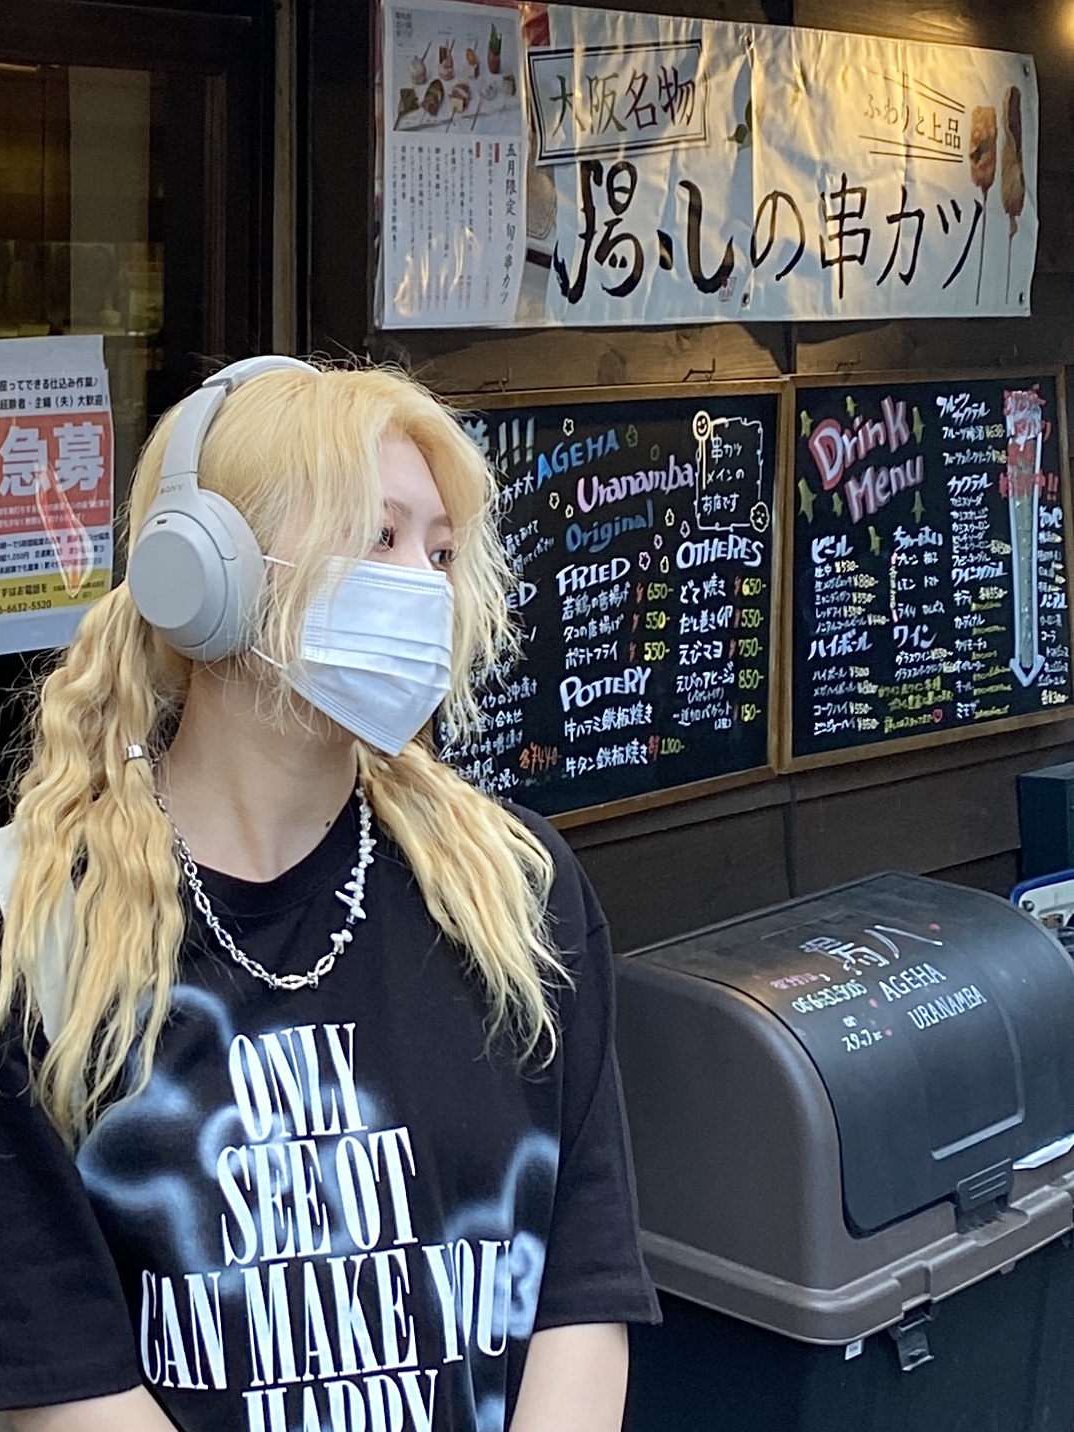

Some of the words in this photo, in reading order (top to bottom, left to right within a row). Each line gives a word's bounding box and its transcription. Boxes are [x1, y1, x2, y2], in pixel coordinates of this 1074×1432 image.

[549, 65, 696, 137] 大阪名物
[863, 93, 962, 150] ふわりと上品
[505, 142, 518, 217] 五月限定
[536, 430, 621, 491] AGEHA
[809, 395, 911, 492] Drink
[577, 455, 694, 513] Uranamba
[701, 492, 741, 516] お店です
[844, 454, 925, 524] Menu
[947, 471, 994, 498] カクテル
[564, 499, 655, 554] Original
[811, 534, 854, 564] ビール
[555, 557, 631, 597] FRIED
[565, 640, 618, 671] ポテトフライ
[678, 638, 724, 666] えびマヨ
[806, 628, 873, 661] ハイボール
[892, 624, 938, 650] ワイン
[559, 666, 653, 713] POTTERY
[877, 962, 947, 1003] AGEHA
[907, 983, 988, 1031] URANAMBA
[227, 1021, 369, 1144] ONLY
[216, 1138, 332, 1267] SEE
[140, 1268, 228, 1391] CAN
[240, 1246, 419, 1389] MAKE
[422, 1237, 513, 1365] YOU
